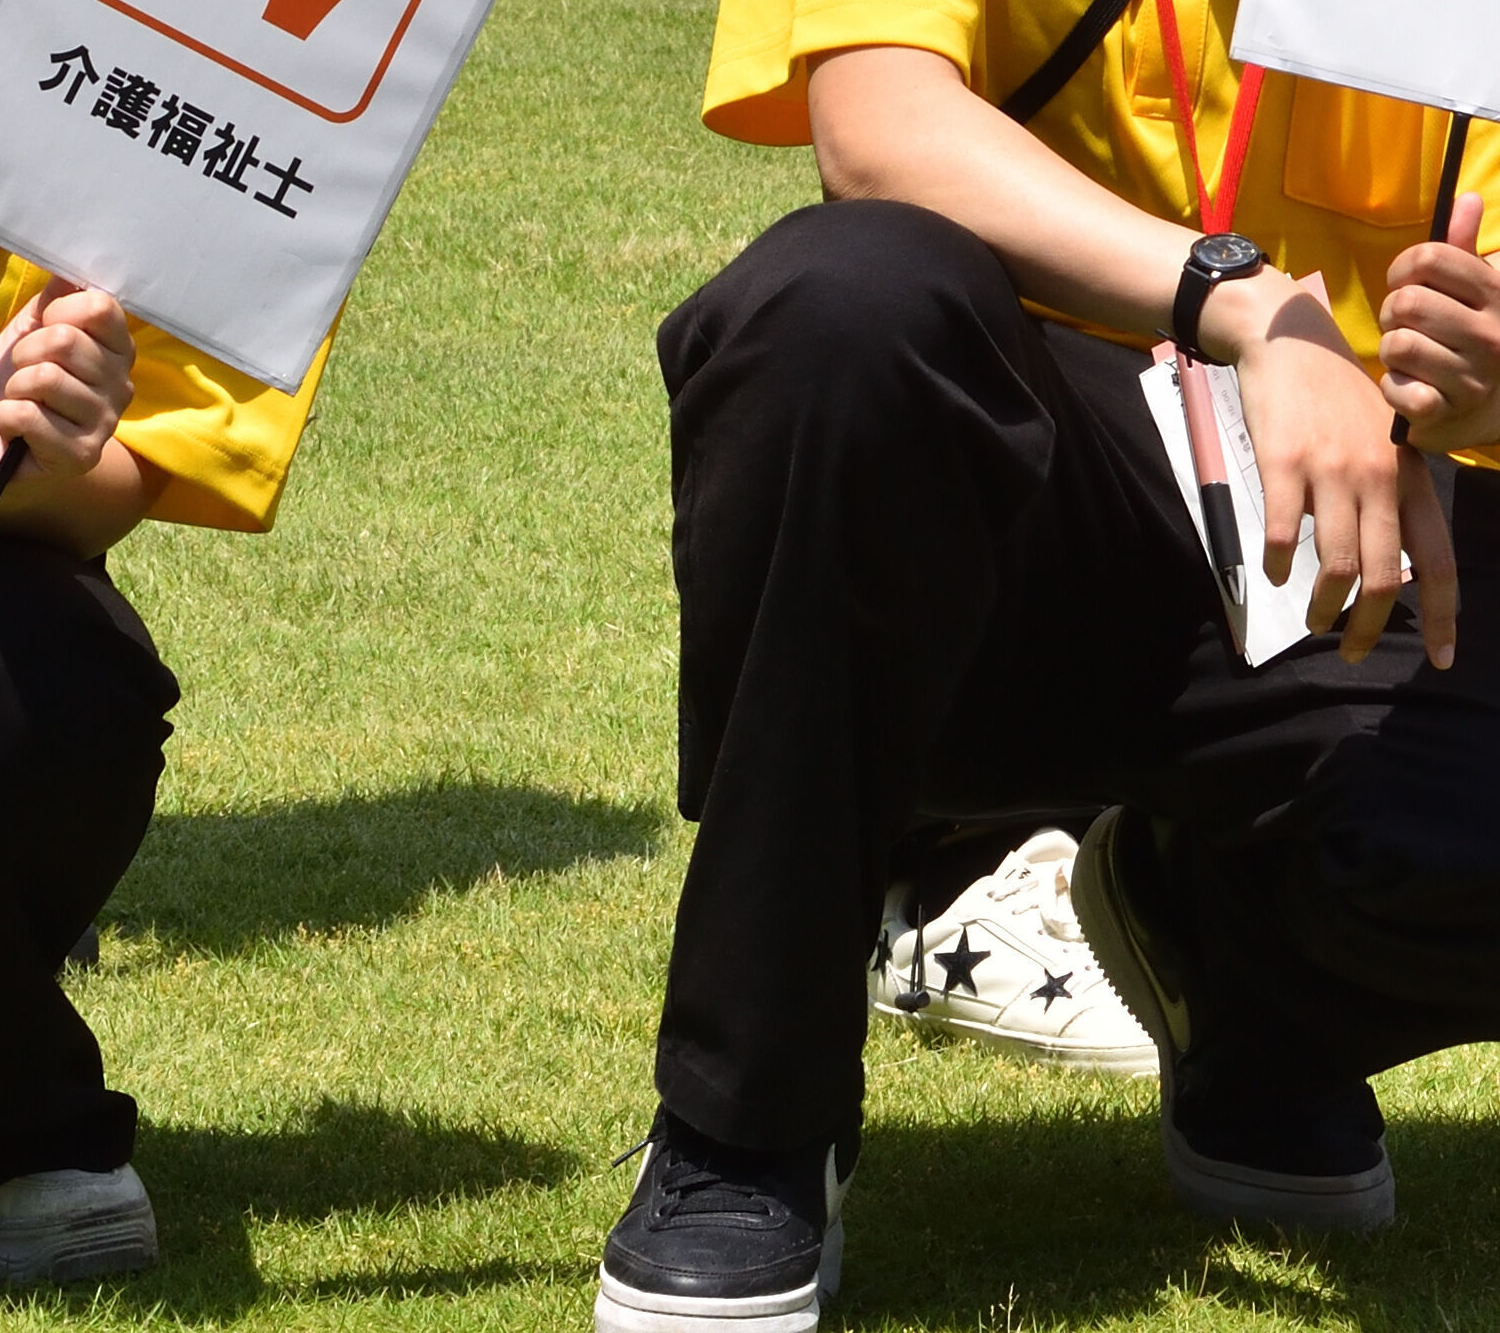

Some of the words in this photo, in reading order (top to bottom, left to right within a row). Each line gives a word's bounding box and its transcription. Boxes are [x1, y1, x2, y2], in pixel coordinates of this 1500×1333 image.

[38, 45, 315, 219] 介護福祉士
